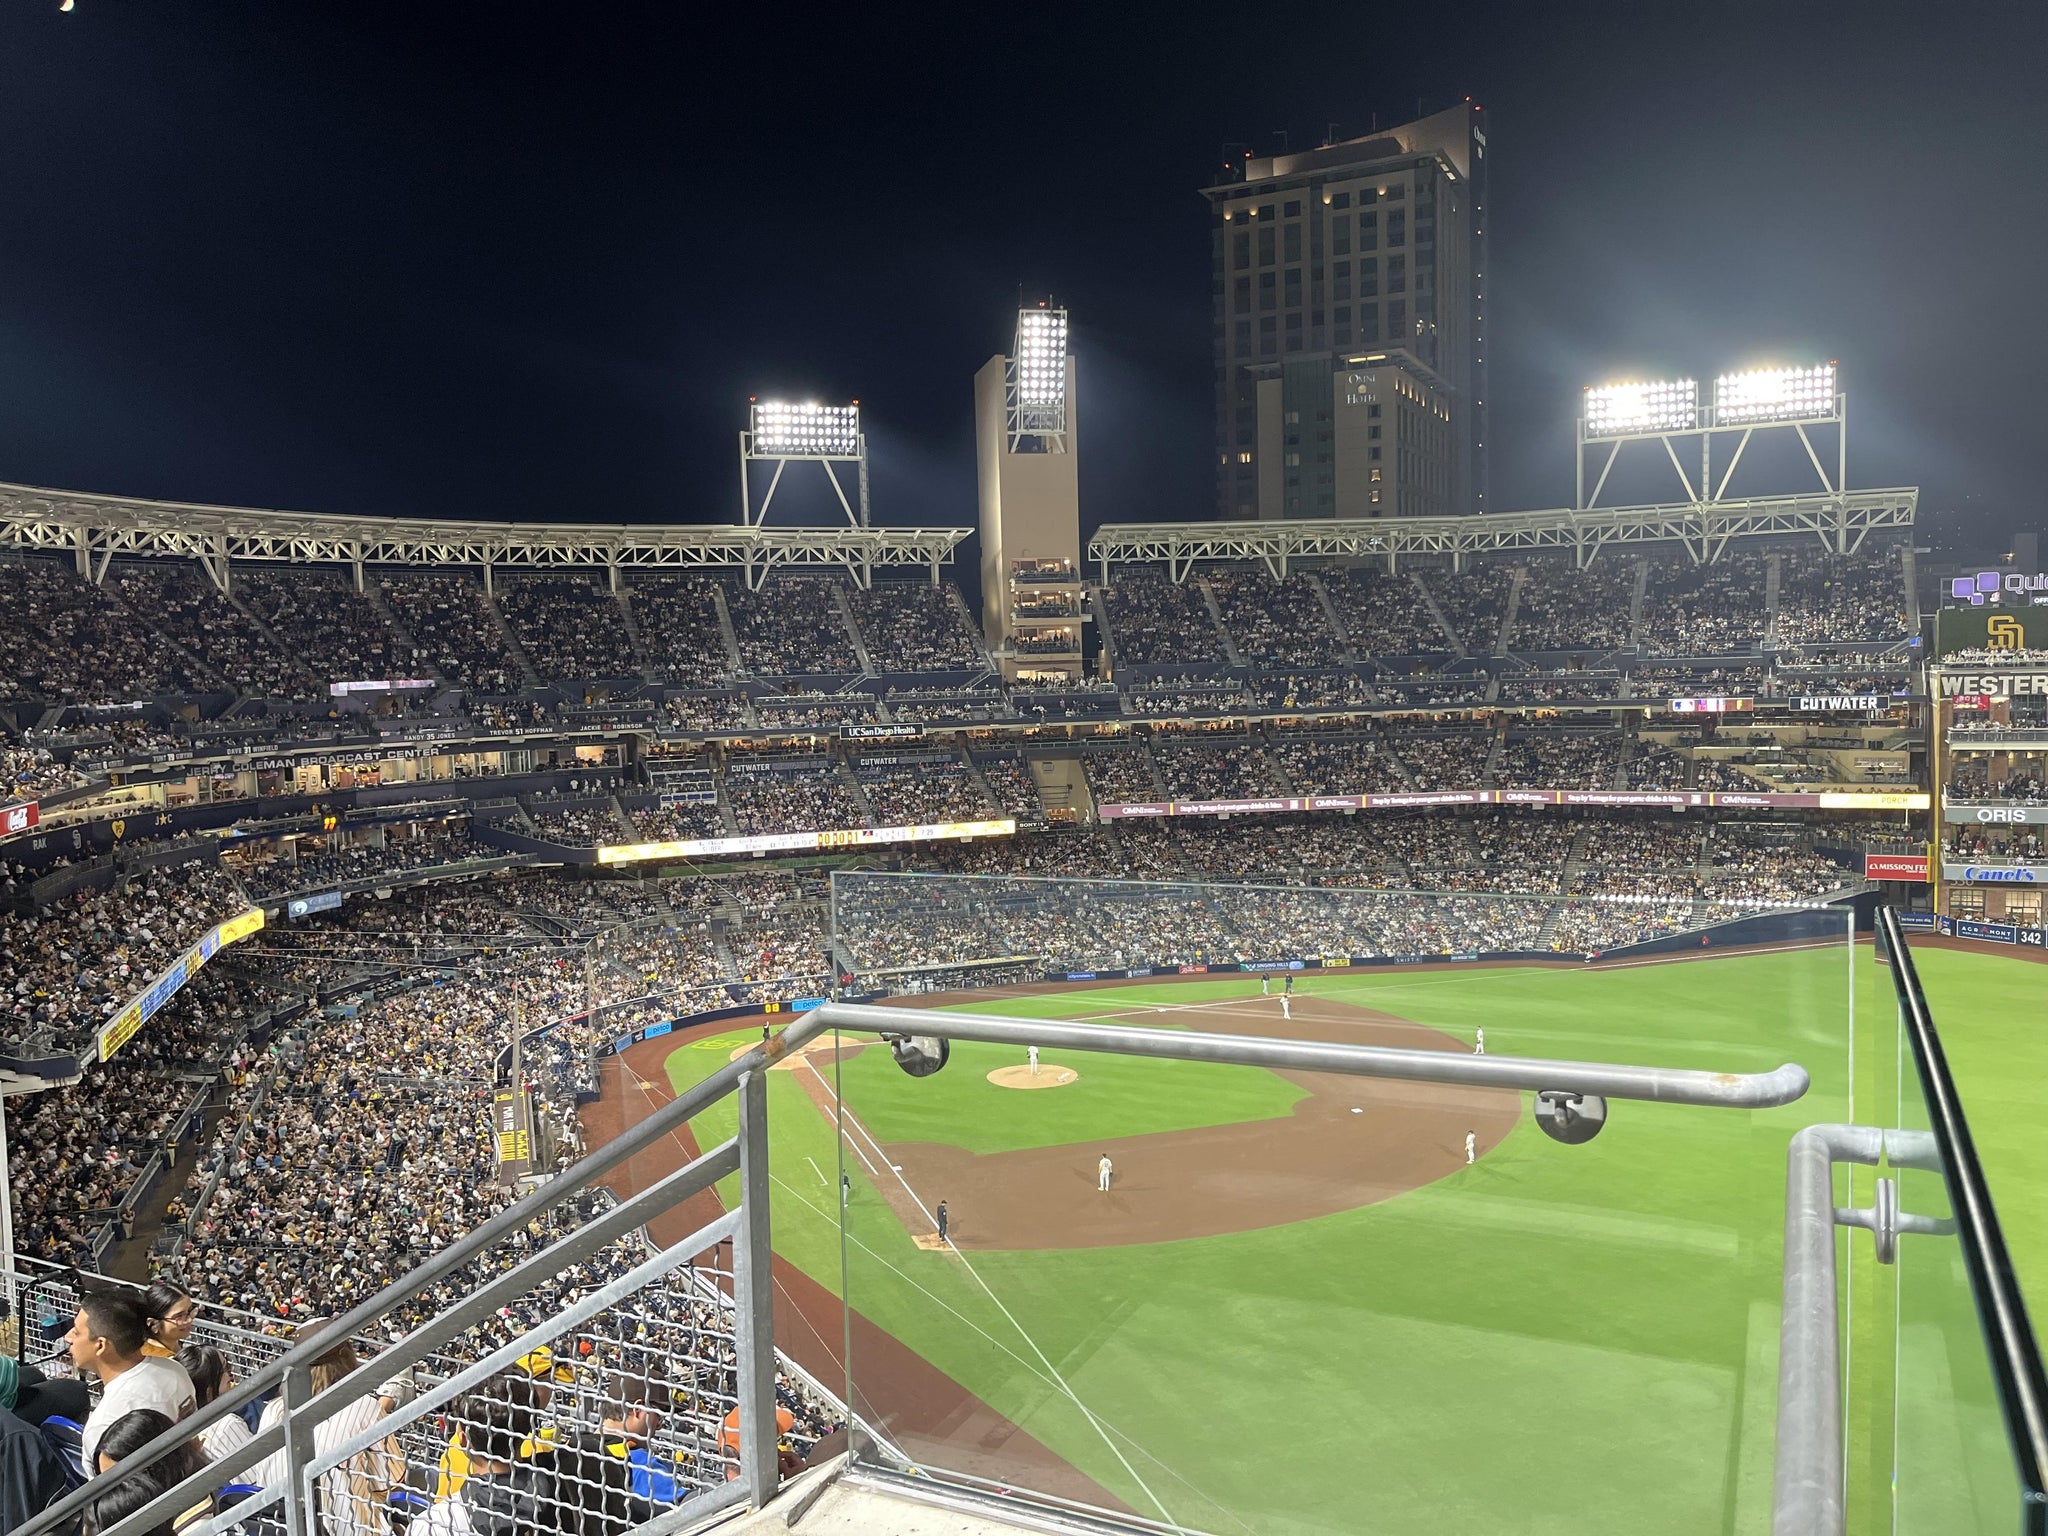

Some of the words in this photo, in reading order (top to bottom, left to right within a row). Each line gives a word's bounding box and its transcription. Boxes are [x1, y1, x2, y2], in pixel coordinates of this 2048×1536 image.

[1941, 675, 2048, 696] WESTER
[1800, 697, 1878, 710] CUTWATER
[580, 724, 600, 732] JACKIE
[848, 728, 860, 736] UC
[861, 727, 873, 736] San
[874, 727, 893, 737] Diego
[894, 726, 915, 735] Health
[436, 732, 455, 740] JONES
[252, 745, 279, 753] WINFIELD
[186, 766, 226, 777] JERRY
[232, 759, 296, 772] COLEMAN
[301, 751, 381, 765] BROADCAST
[387, 748, 440, 759] CENTER
[860, 757, 897, 766] CUTWATER
[731, 763, 771, 772] CUTWATER
[1506, 793, 1529, 801] OMNI
[1722, 796, 1747, 804] OMNI
[1315, 799, 1337, 807] OMNI
[1977, 809, 2026, 822] ORIS
[33, 838, 47, 850] RAK
[1879, 863, 1912, 871] MISSION
[2020, 931, 2041, 944] 342
[803, 1000, 822, 1008] petco
